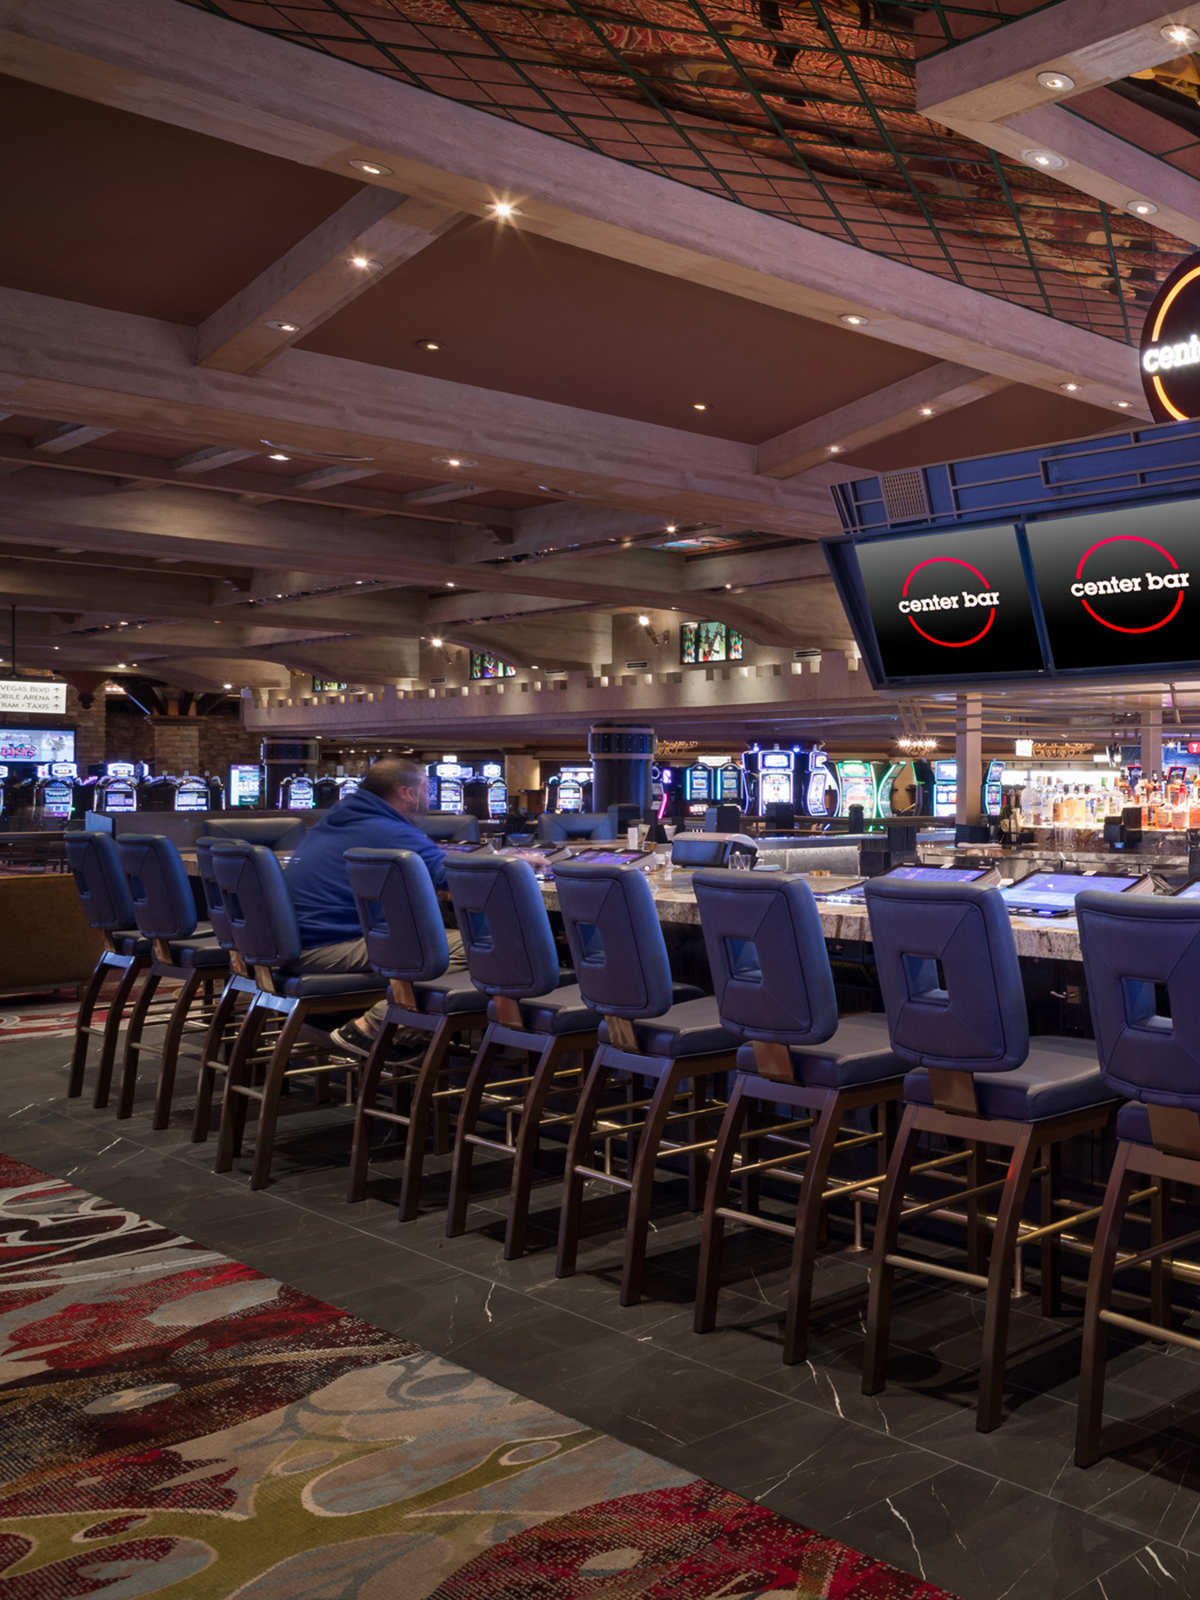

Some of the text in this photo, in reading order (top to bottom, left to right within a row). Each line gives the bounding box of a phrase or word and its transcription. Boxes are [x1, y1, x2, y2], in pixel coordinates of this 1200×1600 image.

[1070, 572, 1190, 597] center bar
[898, 590, 1000, 614] center bar
